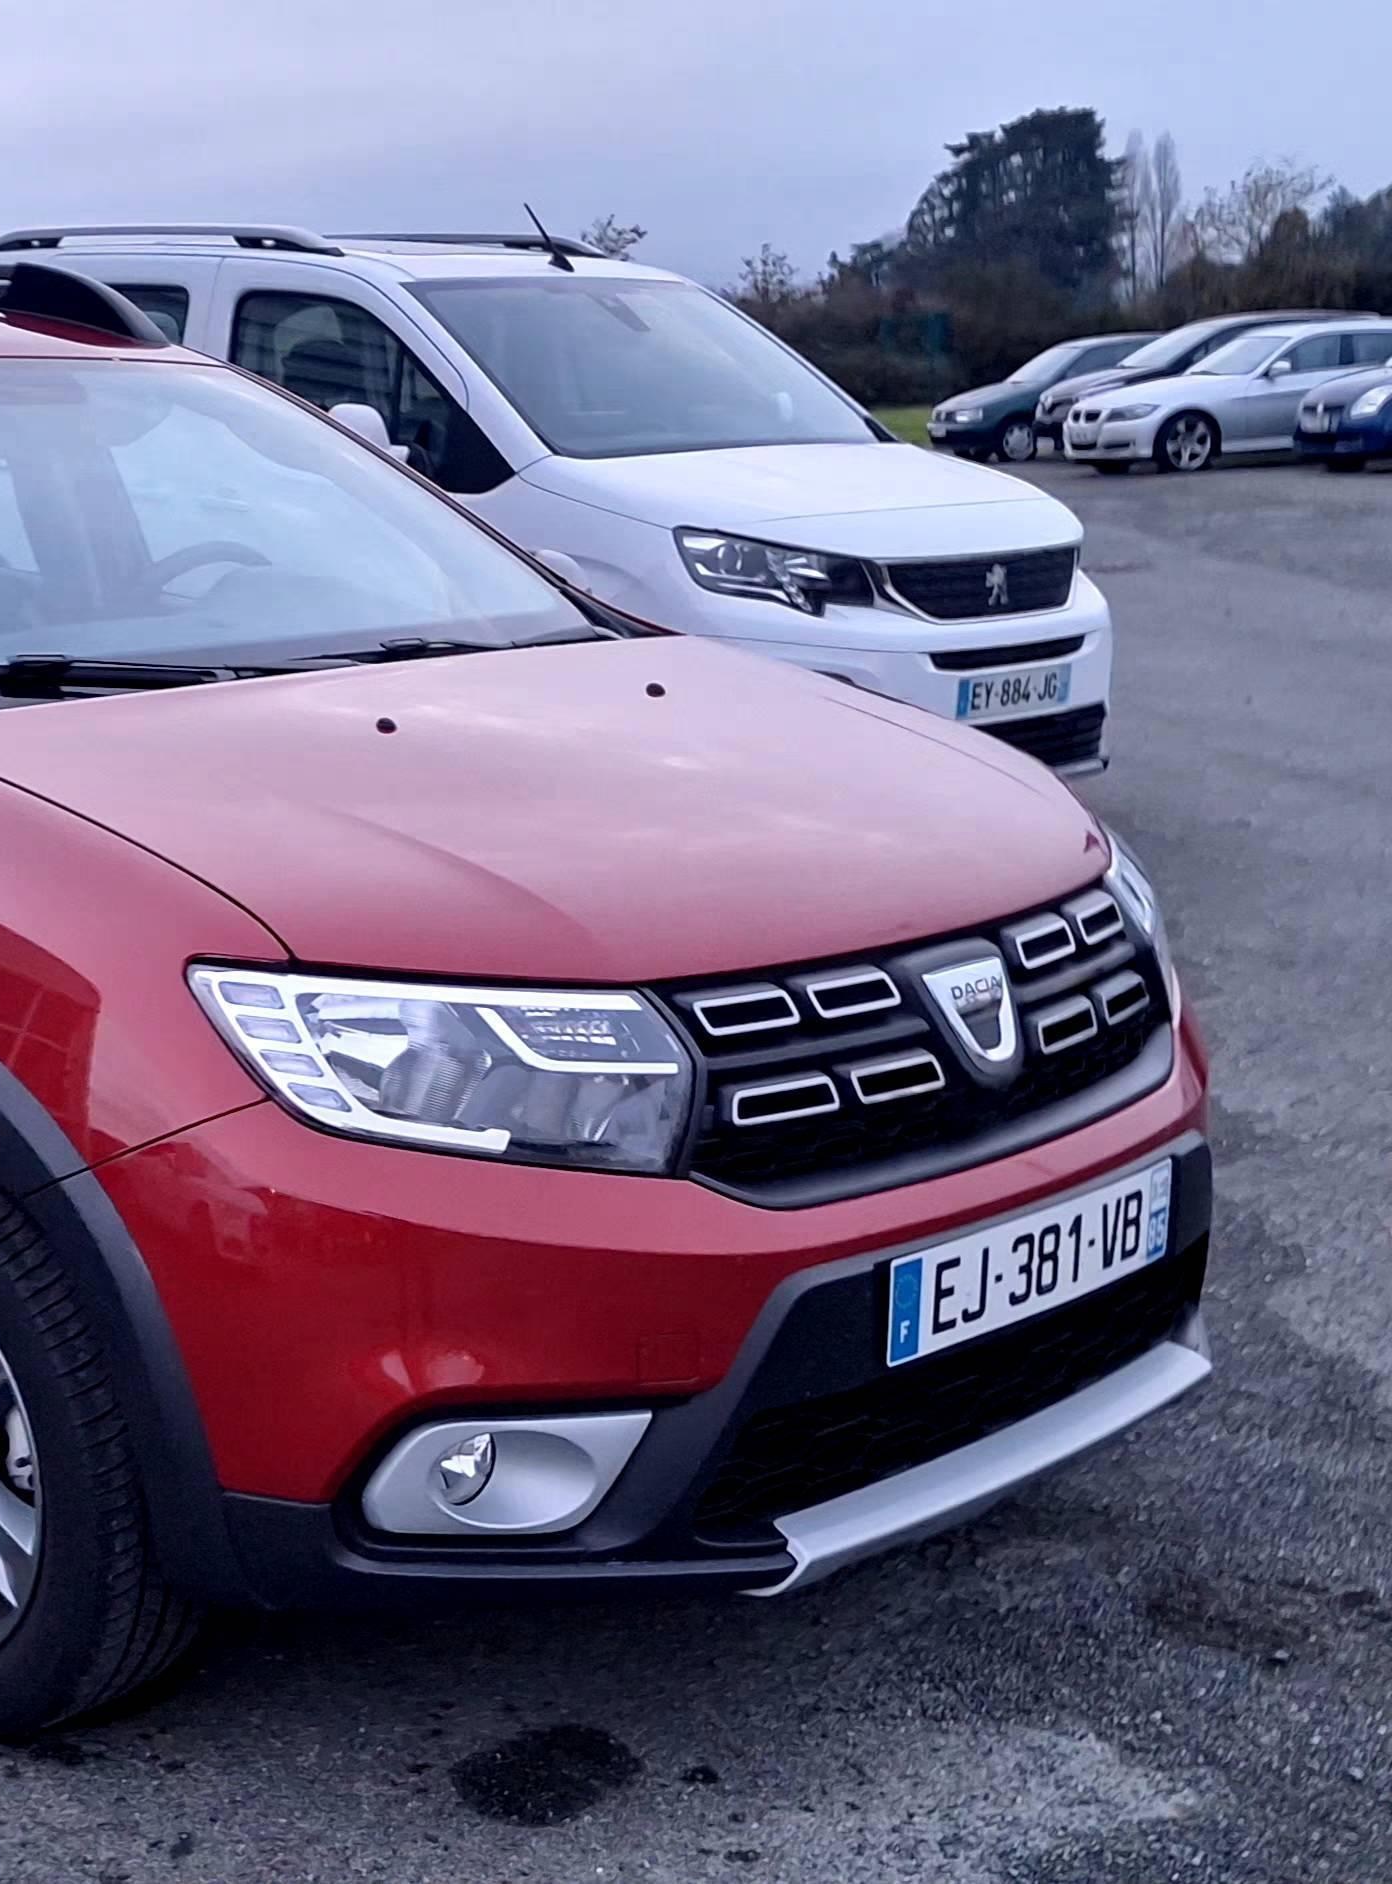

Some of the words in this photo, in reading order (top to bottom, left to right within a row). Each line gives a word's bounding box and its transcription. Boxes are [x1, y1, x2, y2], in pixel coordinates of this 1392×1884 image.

[951, 976, 1003, 1000] DACIA
[932, 1189, 1143, 1336] EJ-381-VB
[899, 1320, 911, 1344] F
